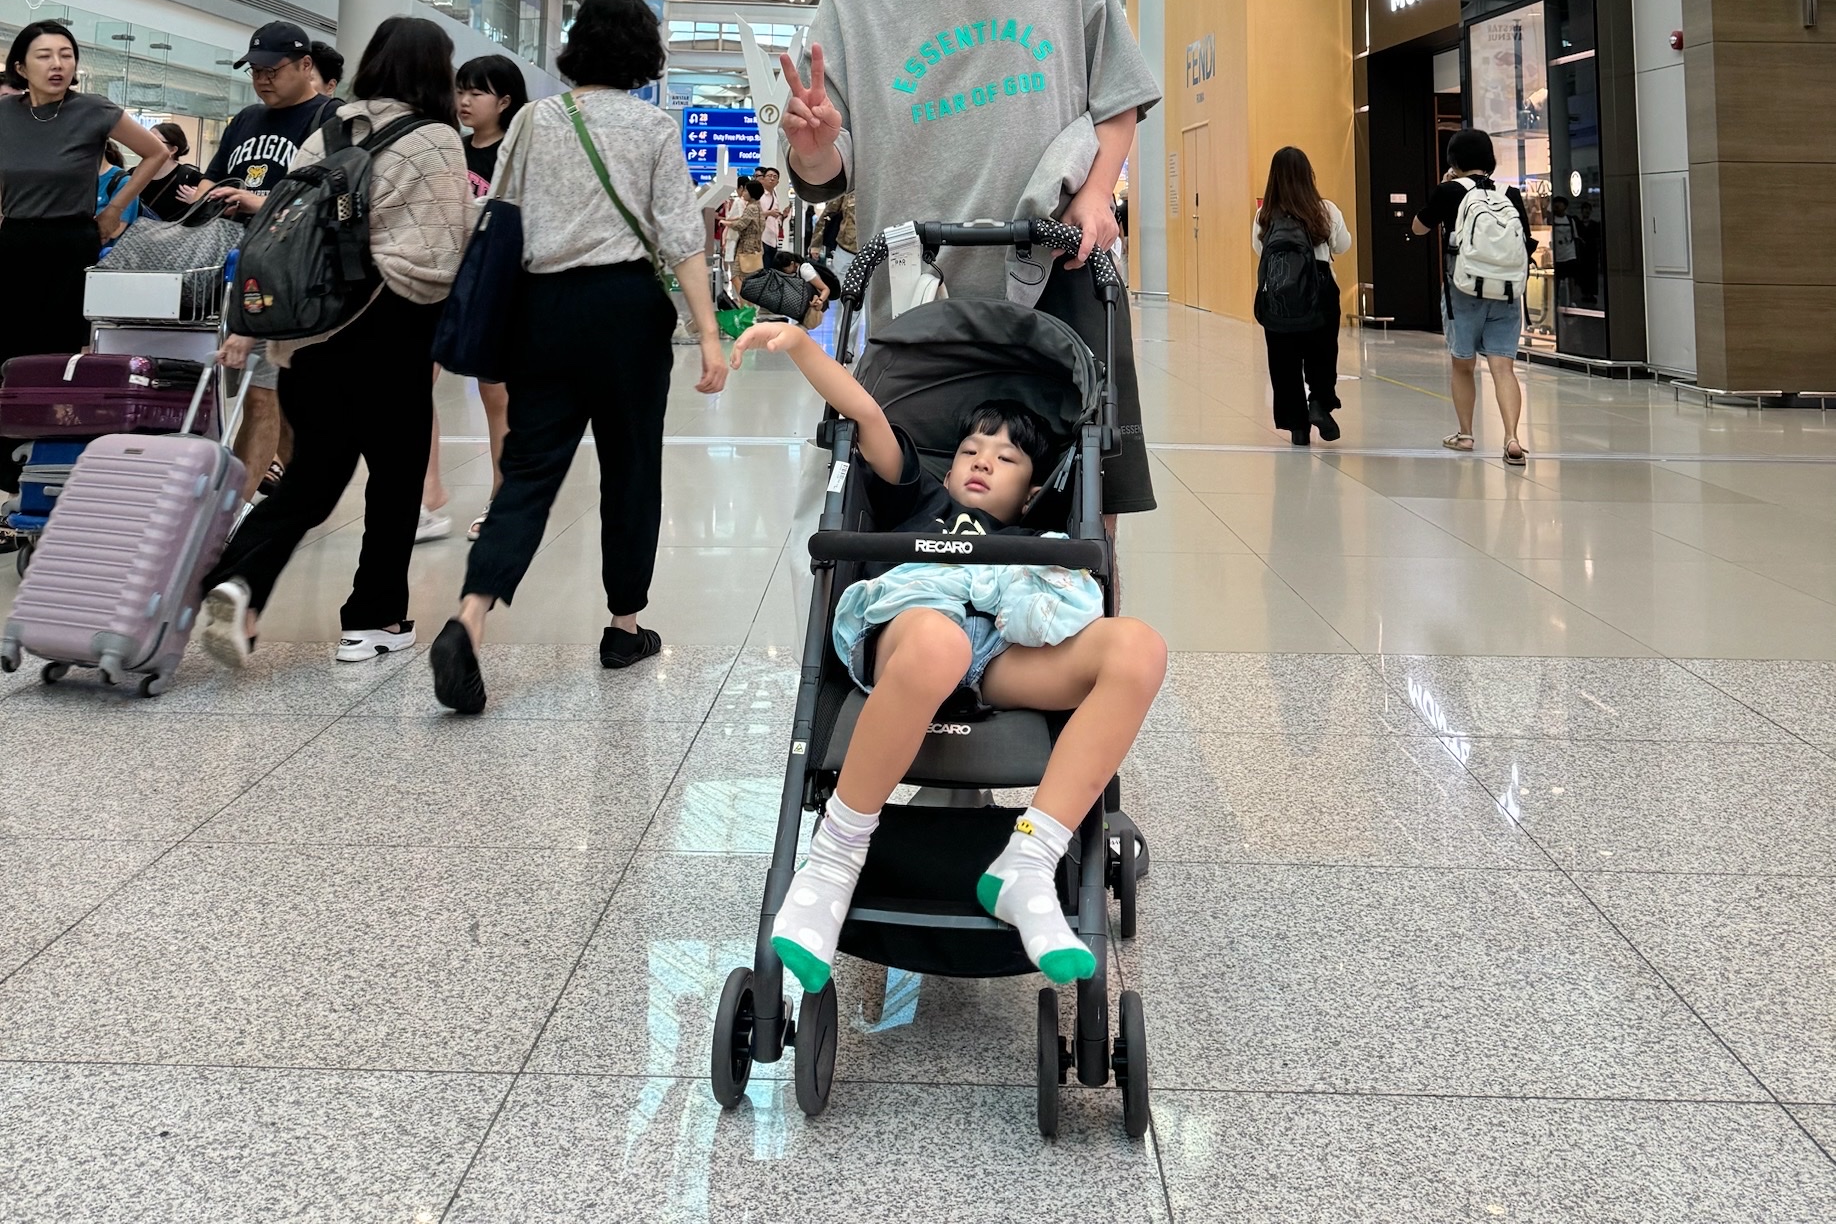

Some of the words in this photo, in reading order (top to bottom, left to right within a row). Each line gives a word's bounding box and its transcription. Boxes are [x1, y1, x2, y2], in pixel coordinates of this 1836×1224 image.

[892, 18, 1054, 95] ESSENTIALS
[1186, 31, 1216, 89] FENDI
[911, 92, 967, 124] FEAR
[971, 82, 998, 106] OF
[1003, 71, 1046, 96] GOD
[915, 538, 973, 555] RECARO
